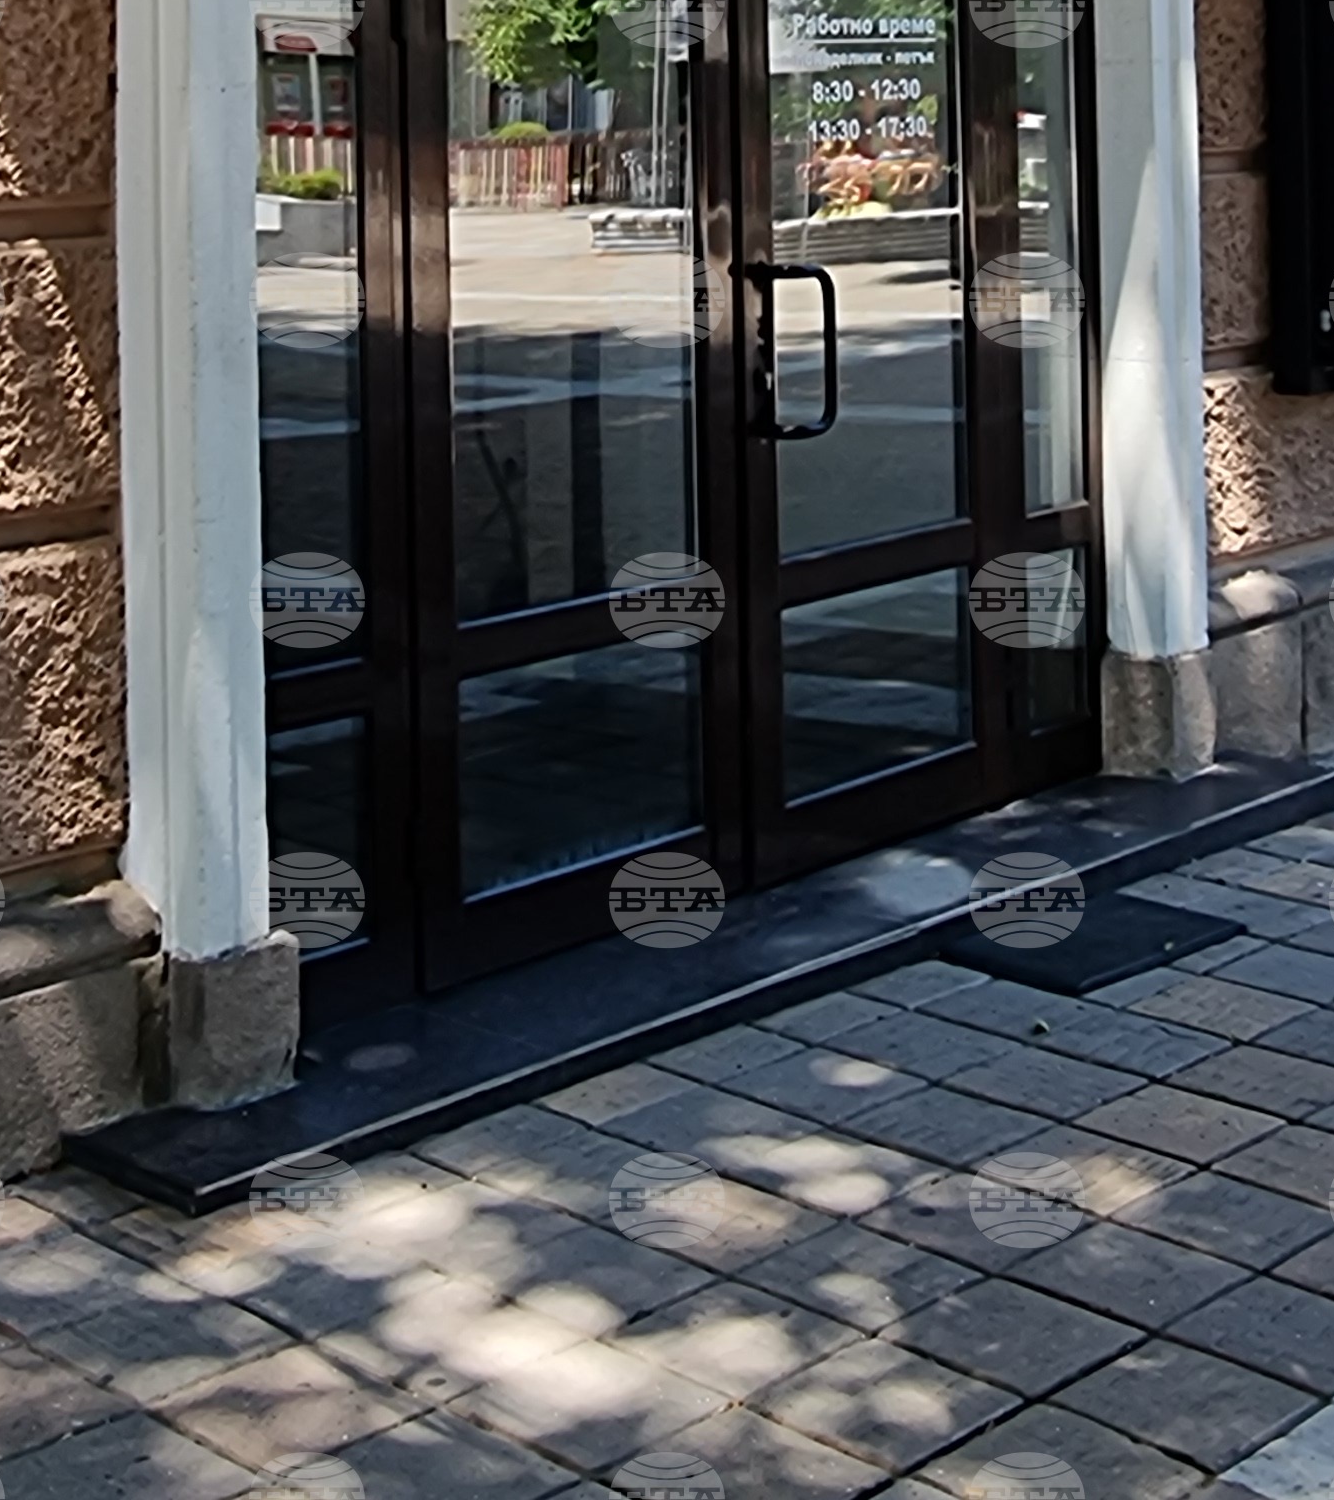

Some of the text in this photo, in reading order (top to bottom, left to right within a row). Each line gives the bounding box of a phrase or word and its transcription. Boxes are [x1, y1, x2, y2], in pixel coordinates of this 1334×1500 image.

[793, 13, 936, 40] Работно време
[813, 79, 854, 103] 8:30
[871, 78, 921, 101] 12:30
[809, 118, 861, 142] 13:30
[877, 116, 927, 139] 17:30
